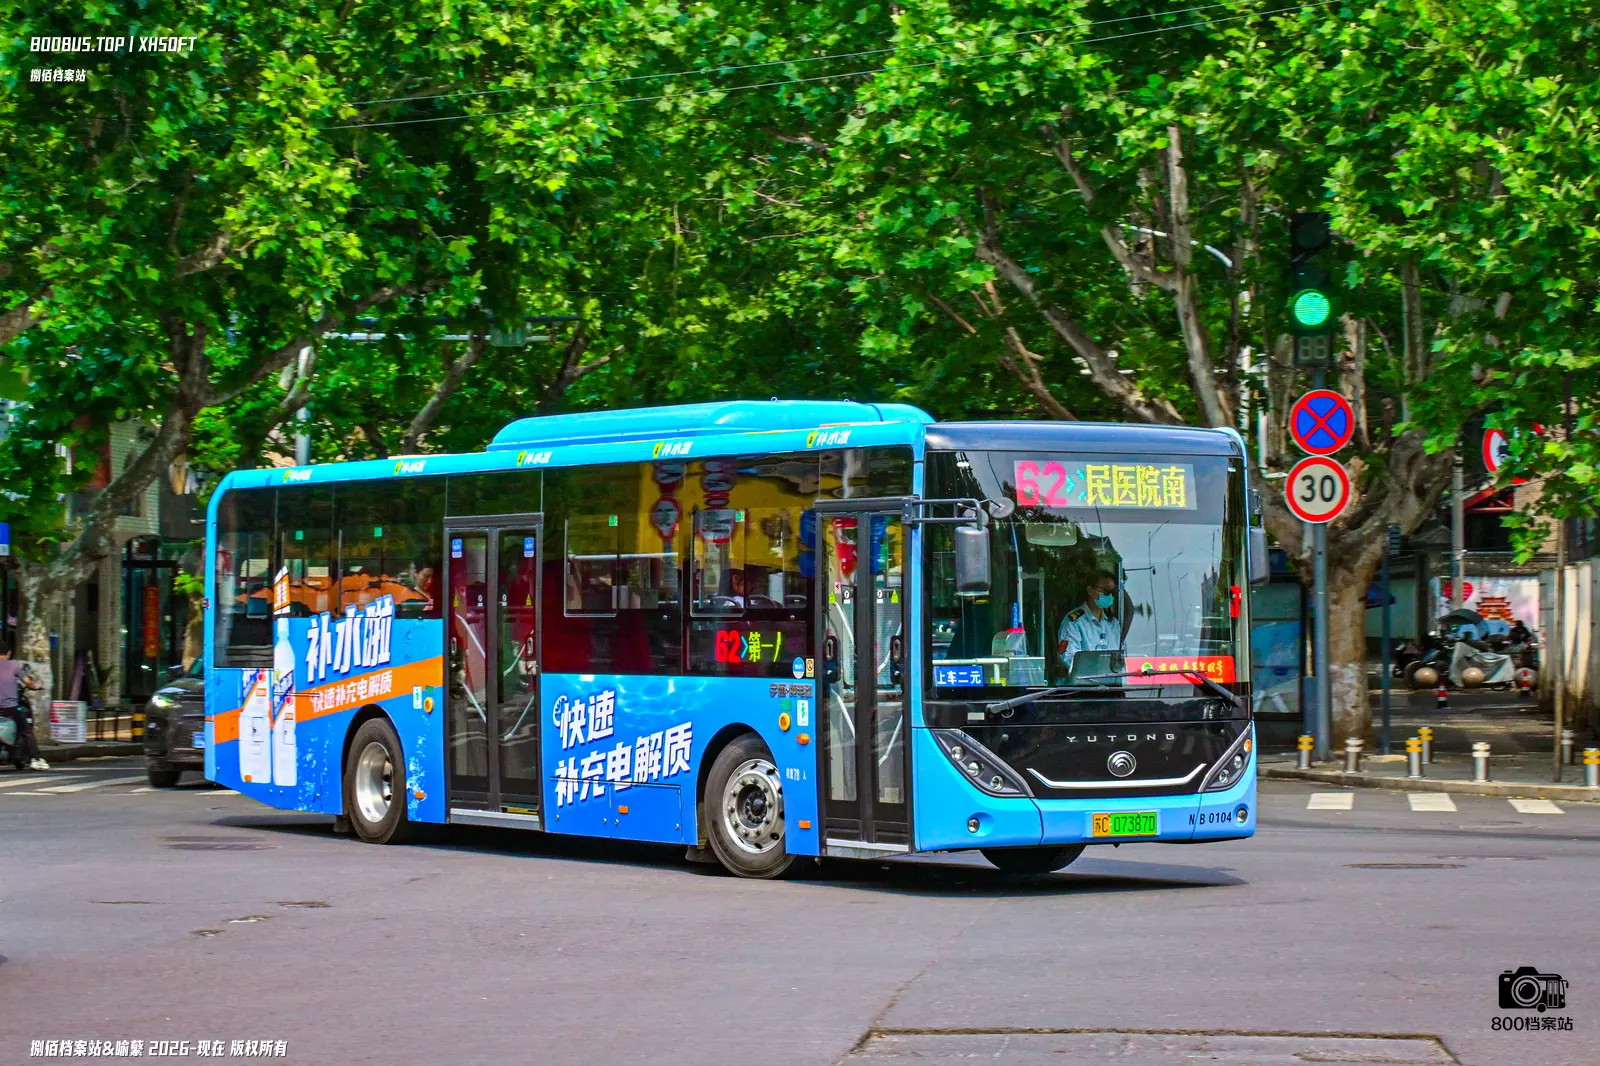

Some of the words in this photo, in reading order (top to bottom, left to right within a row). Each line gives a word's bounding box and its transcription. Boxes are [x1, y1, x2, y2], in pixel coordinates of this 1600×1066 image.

[1016, 460, 1068, 507] 62
[1086, 464, 1187, 508] 民医院南
[1300, 474, 1336, 503] 30
[305, 594, 394, 683] 补水啦
[715, 629, 741, 663] 62
[311, 669, 393, 713] 快速补充电解质
[937, 670, 982, 685] 上车二元
[559, 690, 615, 750] 快速
[1066, 733, 1176, 744] YUTONG
[554, 721, 692, 807] 补充电解质
[1209, 811, 1232, 823] 0104
